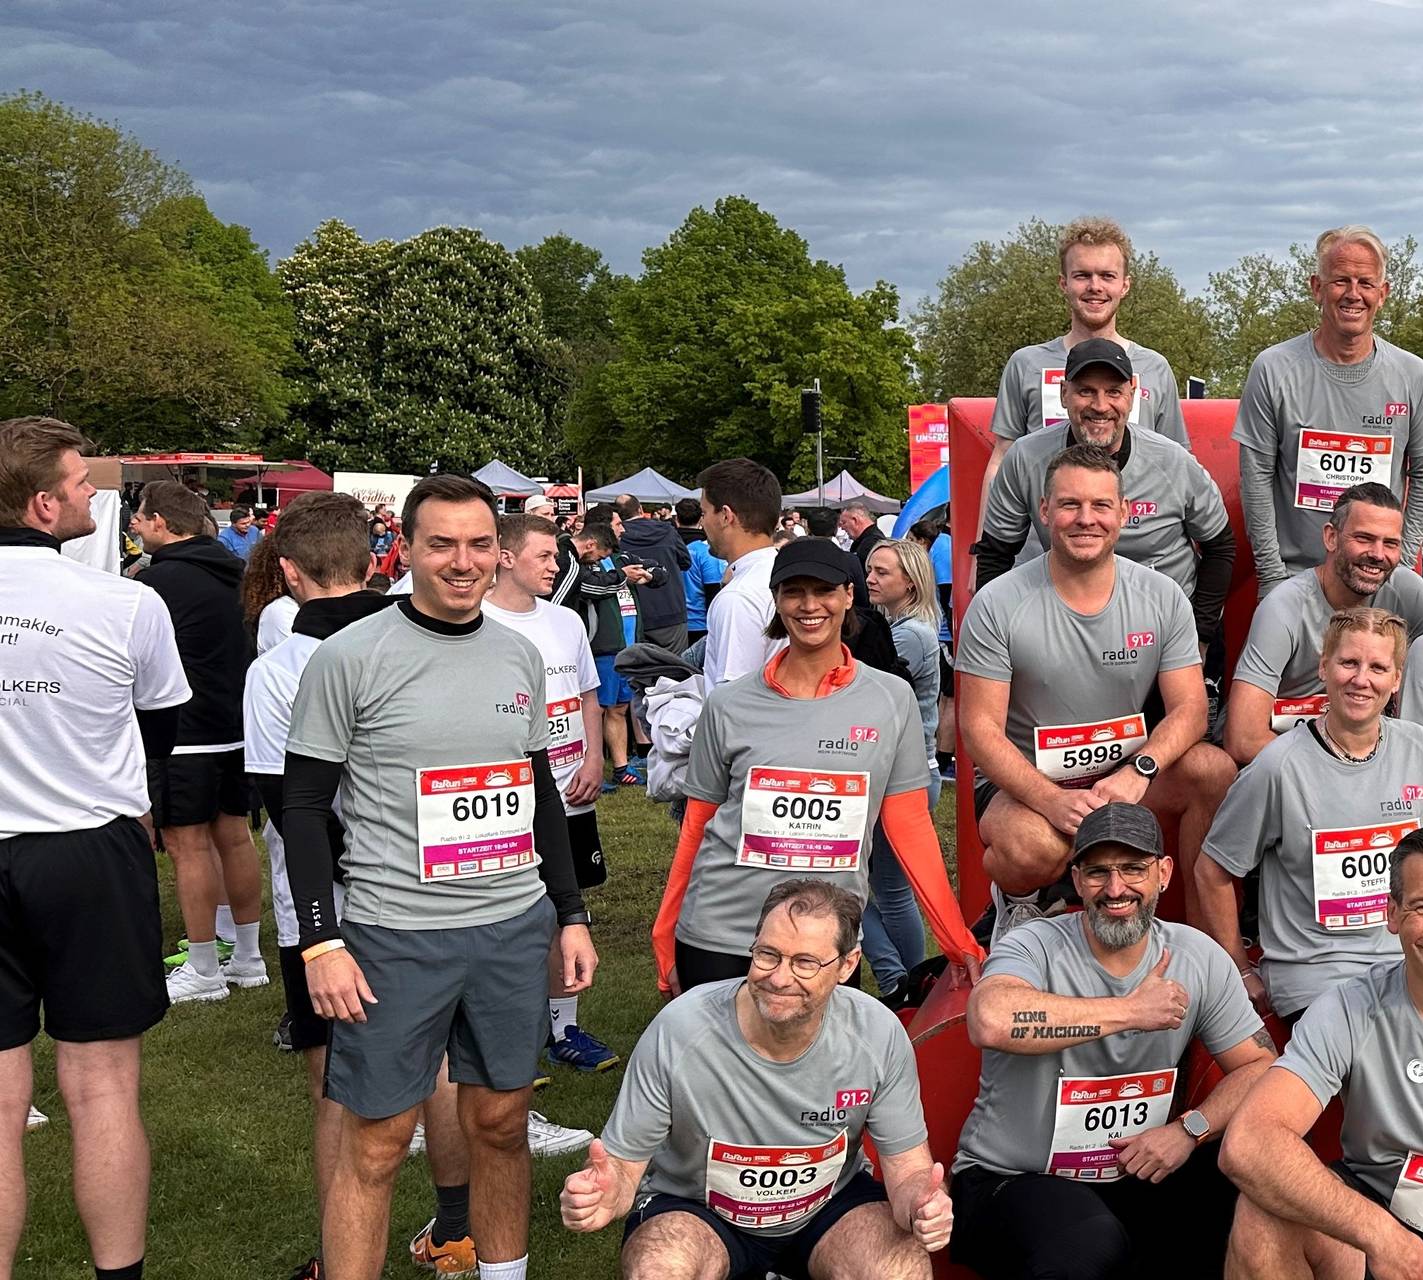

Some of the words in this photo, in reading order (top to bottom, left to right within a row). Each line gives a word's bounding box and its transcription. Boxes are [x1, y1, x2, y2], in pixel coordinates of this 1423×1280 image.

[1362, 415, 1393, 425] radio
[1389, 405, 1407, 416] 91.2
[1320, 453, 1372, 474] 6015
[1135, 504, 1156, 515] 91.2
[1102, 648, 1138, 661] radio
[1132, 634, 1154, 647] 91.2
[496, 702, 525, 715] radio
[818, 738, 859, 751] radio
[855, 729, 877, 743] 91.2
[1062, 743, 1123, 769] 5998
[452, 791, 519, 821] 6019
[772, 796, 842, 821] 6005
[1381, 797, 1412, 812] radio
[1406, 788, 1423, 800] 91.2
[789, 822, 821, 830] KATRIN
[458, 845, 492, 855] STARTZEIT
[1361, 878, 1386, 888] STEFFI
[1013, 1011, 1047, 1023] KING
[1011, 1026, 1029, 1039] OF
[1032, 1025, 1101, 1039] MACHINES
[801, 1106, 846, 1122] radio
[841, 1092, 869, 1107] 91.2
[1084, 1102, 1149, 1132] 6013
[1082, 1153, 1115, 1163] STARTZEIT
[739, 1167, 817, 1188] 6003
[756, 1188, 797, 1197] VOLKER
